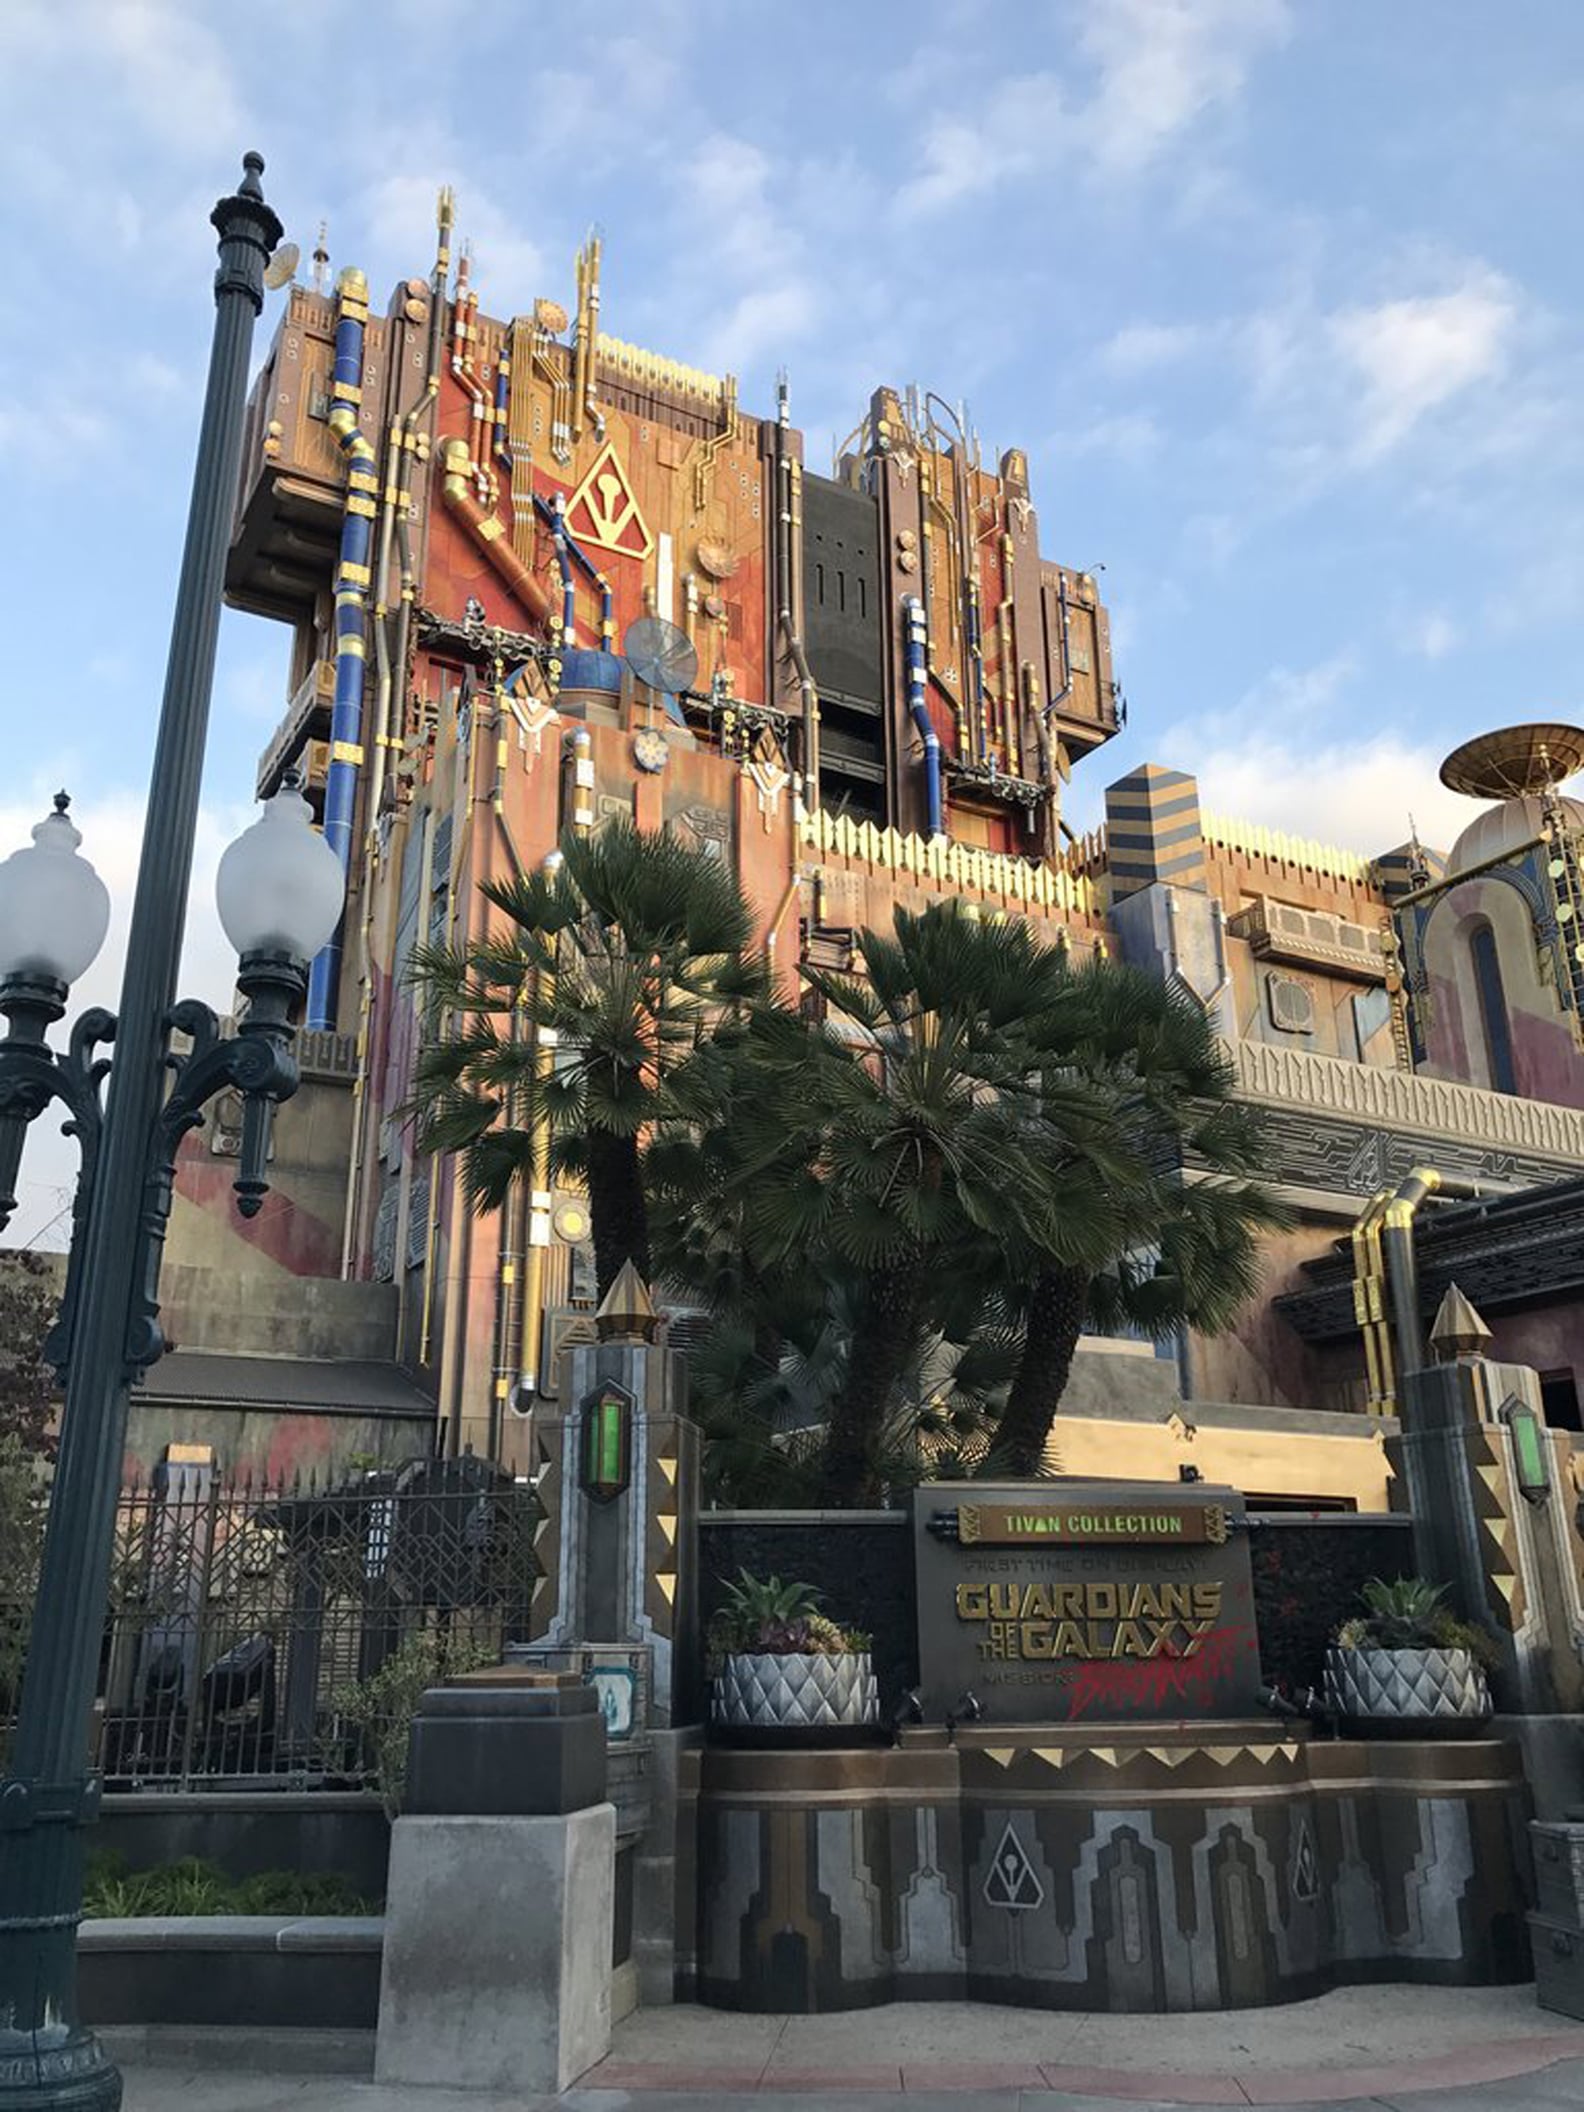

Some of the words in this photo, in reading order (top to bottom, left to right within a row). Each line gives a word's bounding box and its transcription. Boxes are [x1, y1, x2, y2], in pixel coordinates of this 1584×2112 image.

[1005, 1515, 1060, 1533] TIVAN
[1068, 1515, 1182, 1533] COLLECTION
[956, 1582, 1223, 1619] GUARDIANS
[990, 1622, 1017, 1639] OF
[1020, 1620, 1216, 1659] GALAXY
[978, 1641, 1019, 1659] THE
